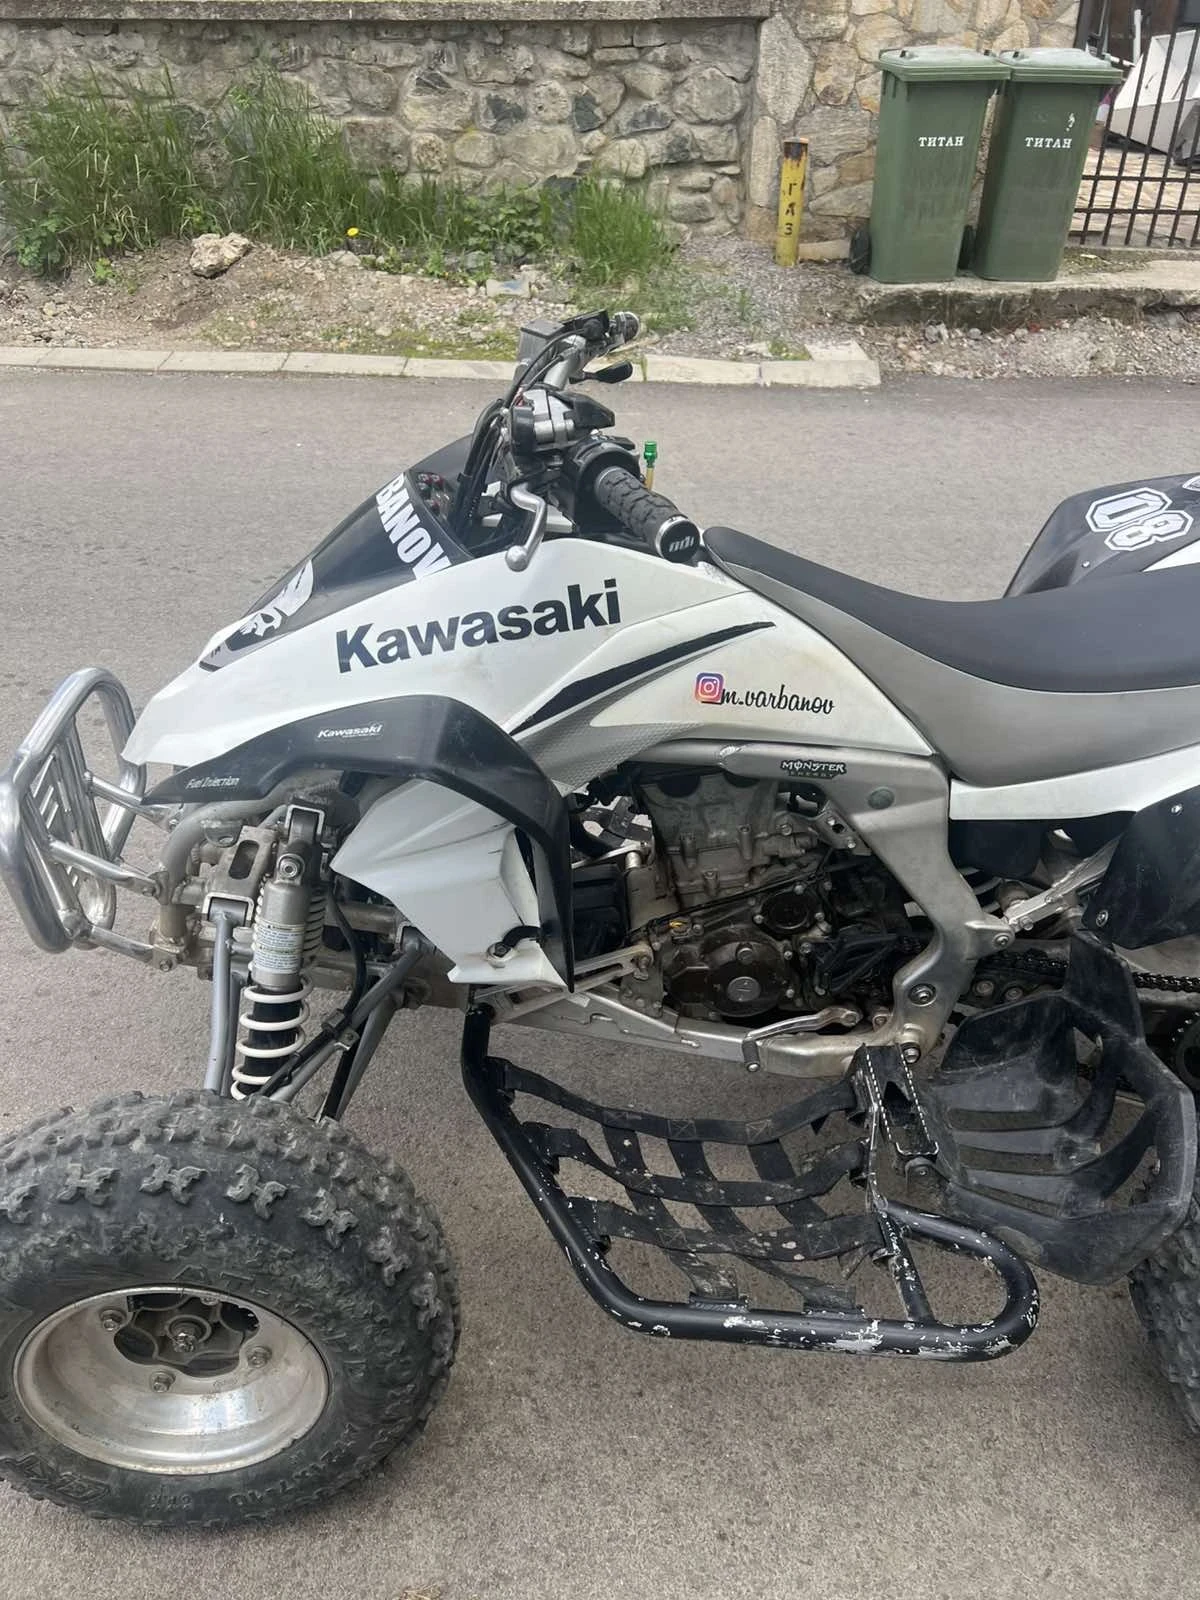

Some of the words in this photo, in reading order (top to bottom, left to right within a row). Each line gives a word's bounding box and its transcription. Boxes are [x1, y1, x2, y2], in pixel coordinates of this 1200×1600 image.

[918, 136, 965, 147] ТИТАН
[1025, 137, 1073, 148] ТИТАН
[336, 578, 621, 674] Kawasaki
[317, 724, 383, 738] Kawasaki
[782, 761, 846, 773] MONSTER
